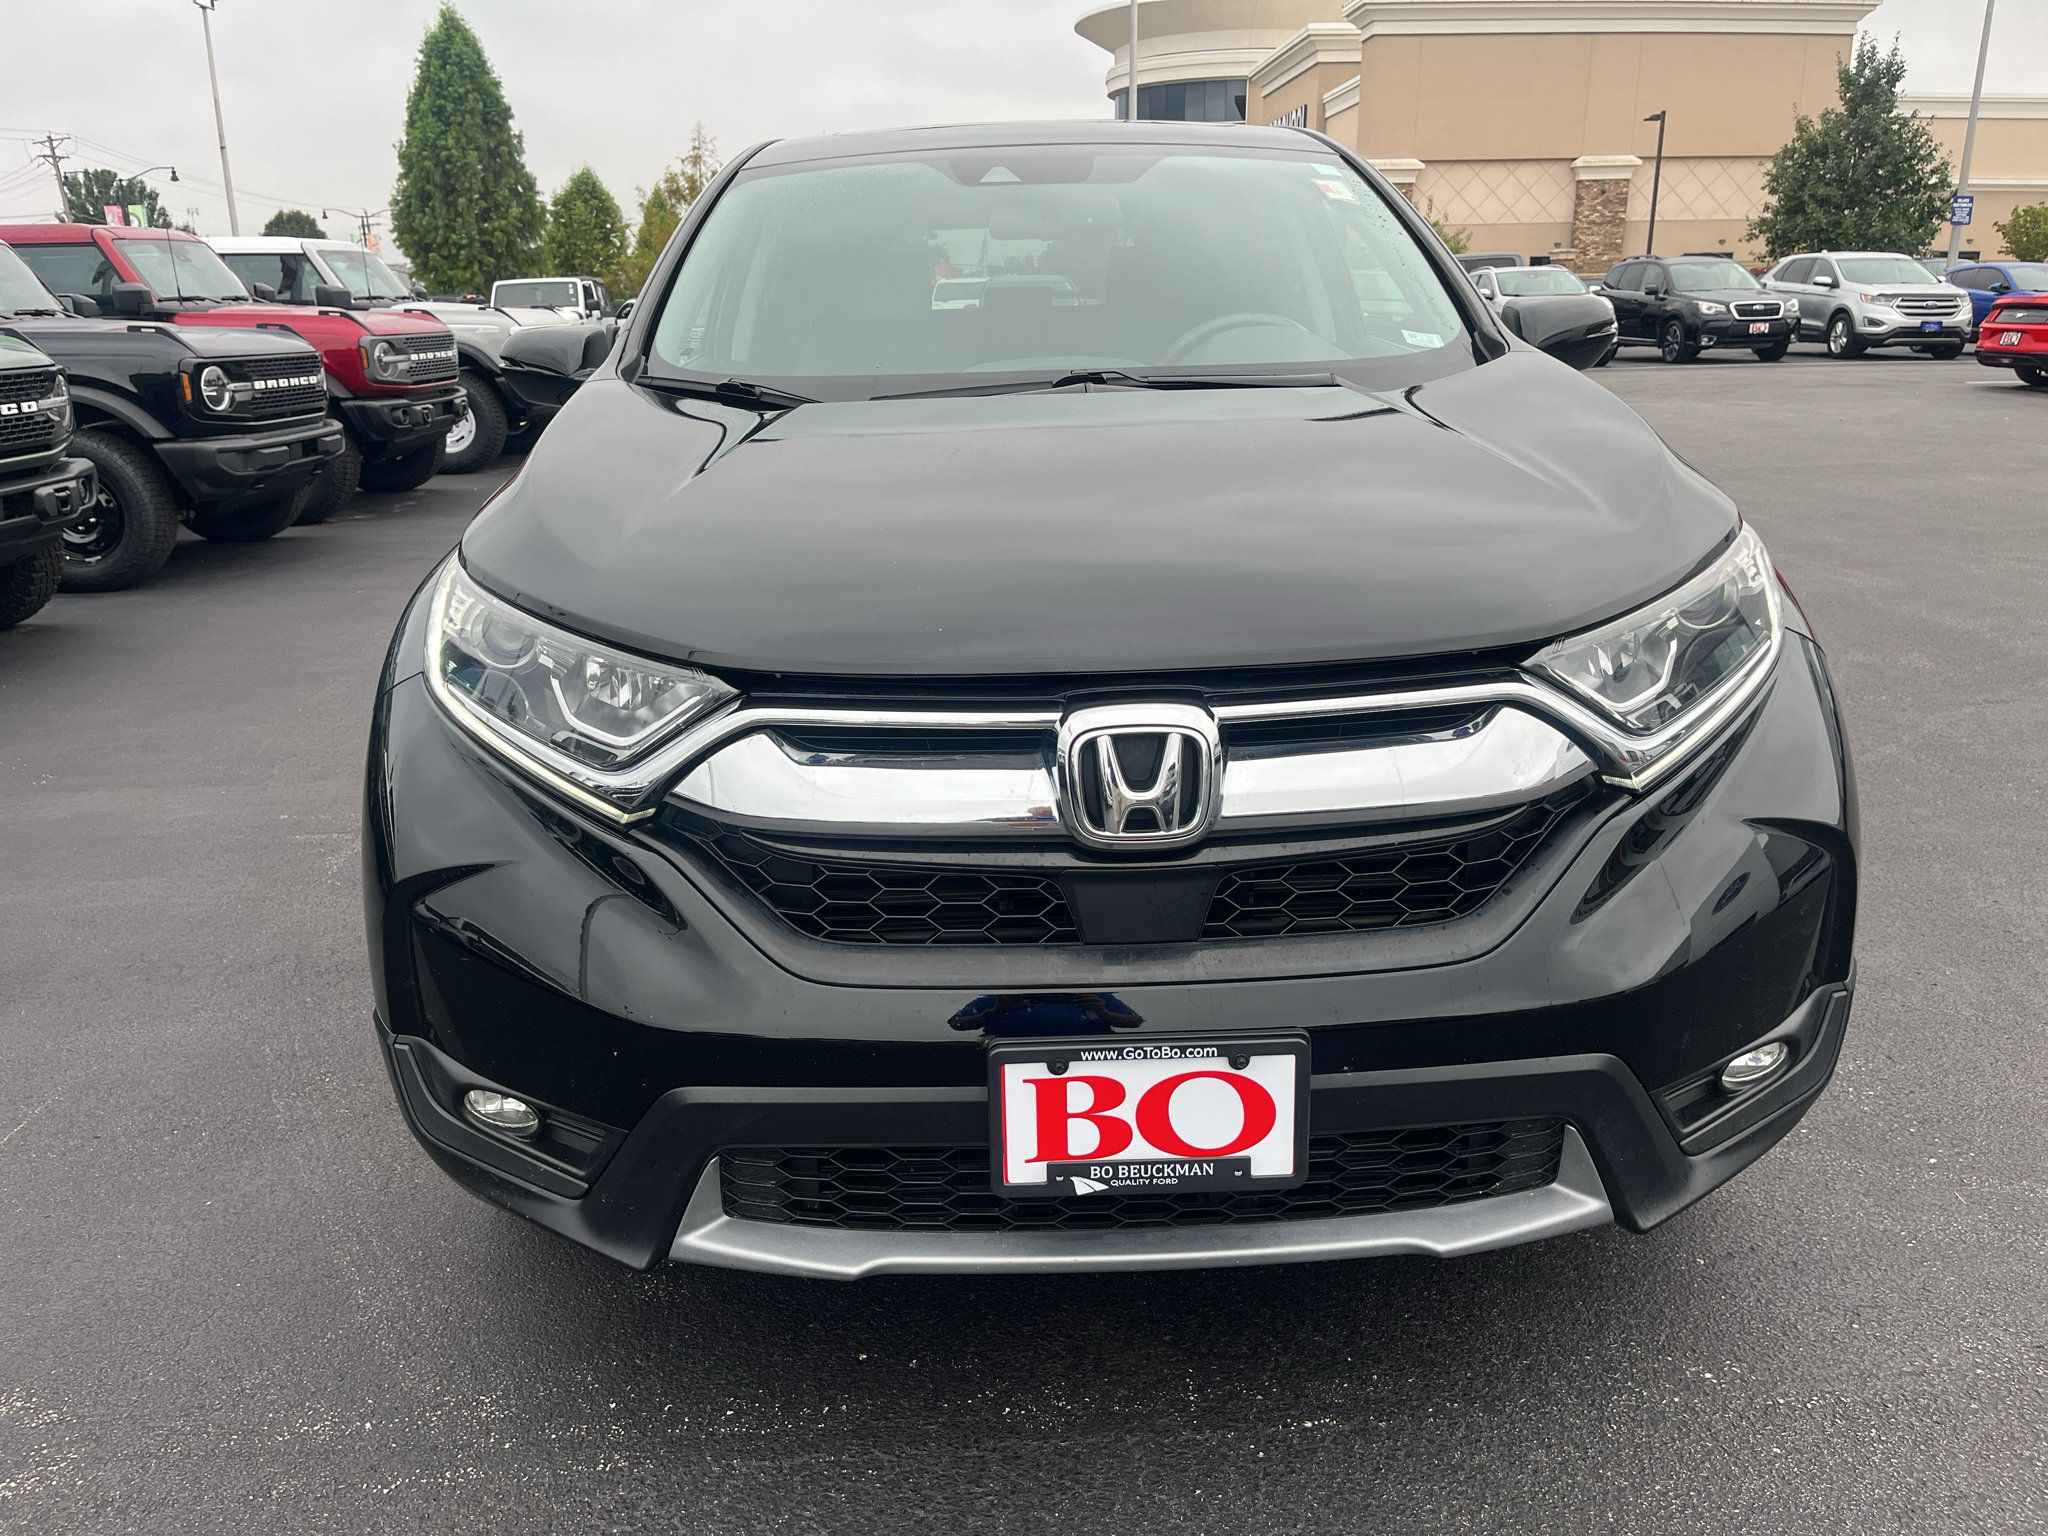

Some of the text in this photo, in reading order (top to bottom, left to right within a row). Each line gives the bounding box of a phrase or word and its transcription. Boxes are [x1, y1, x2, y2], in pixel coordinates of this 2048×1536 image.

[253, 375, 318, 390] BRONCO
[1081, 1046, 1218, 1061] www.GoToBo.com
[1022, 1070, 1277, 1163] BO
[1090, 1162, 1214, 1179] BO BEUCKMAN
[1110, 1177, 1179, 1187] QUALITY FORD
